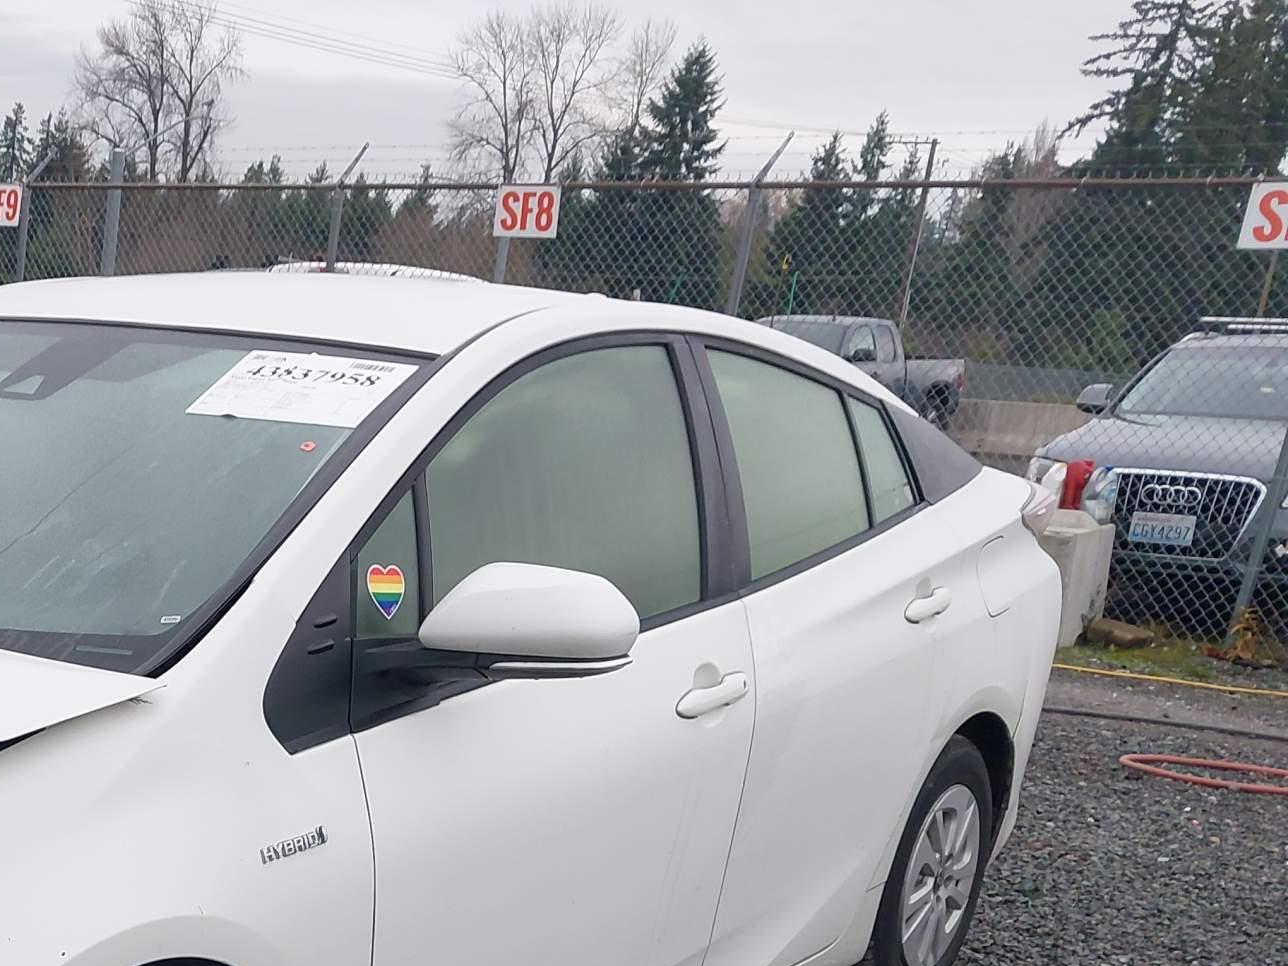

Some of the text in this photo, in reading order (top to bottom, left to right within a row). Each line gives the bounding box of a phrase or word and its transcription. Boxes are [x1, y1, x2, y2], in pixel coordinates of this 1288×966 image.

[500, 190, 555, 232] SF8
[1252, 189, 1288, 242] S
[246, 364, 382, 387] 43837958
[259, 831, 317, 865] HYBRID
